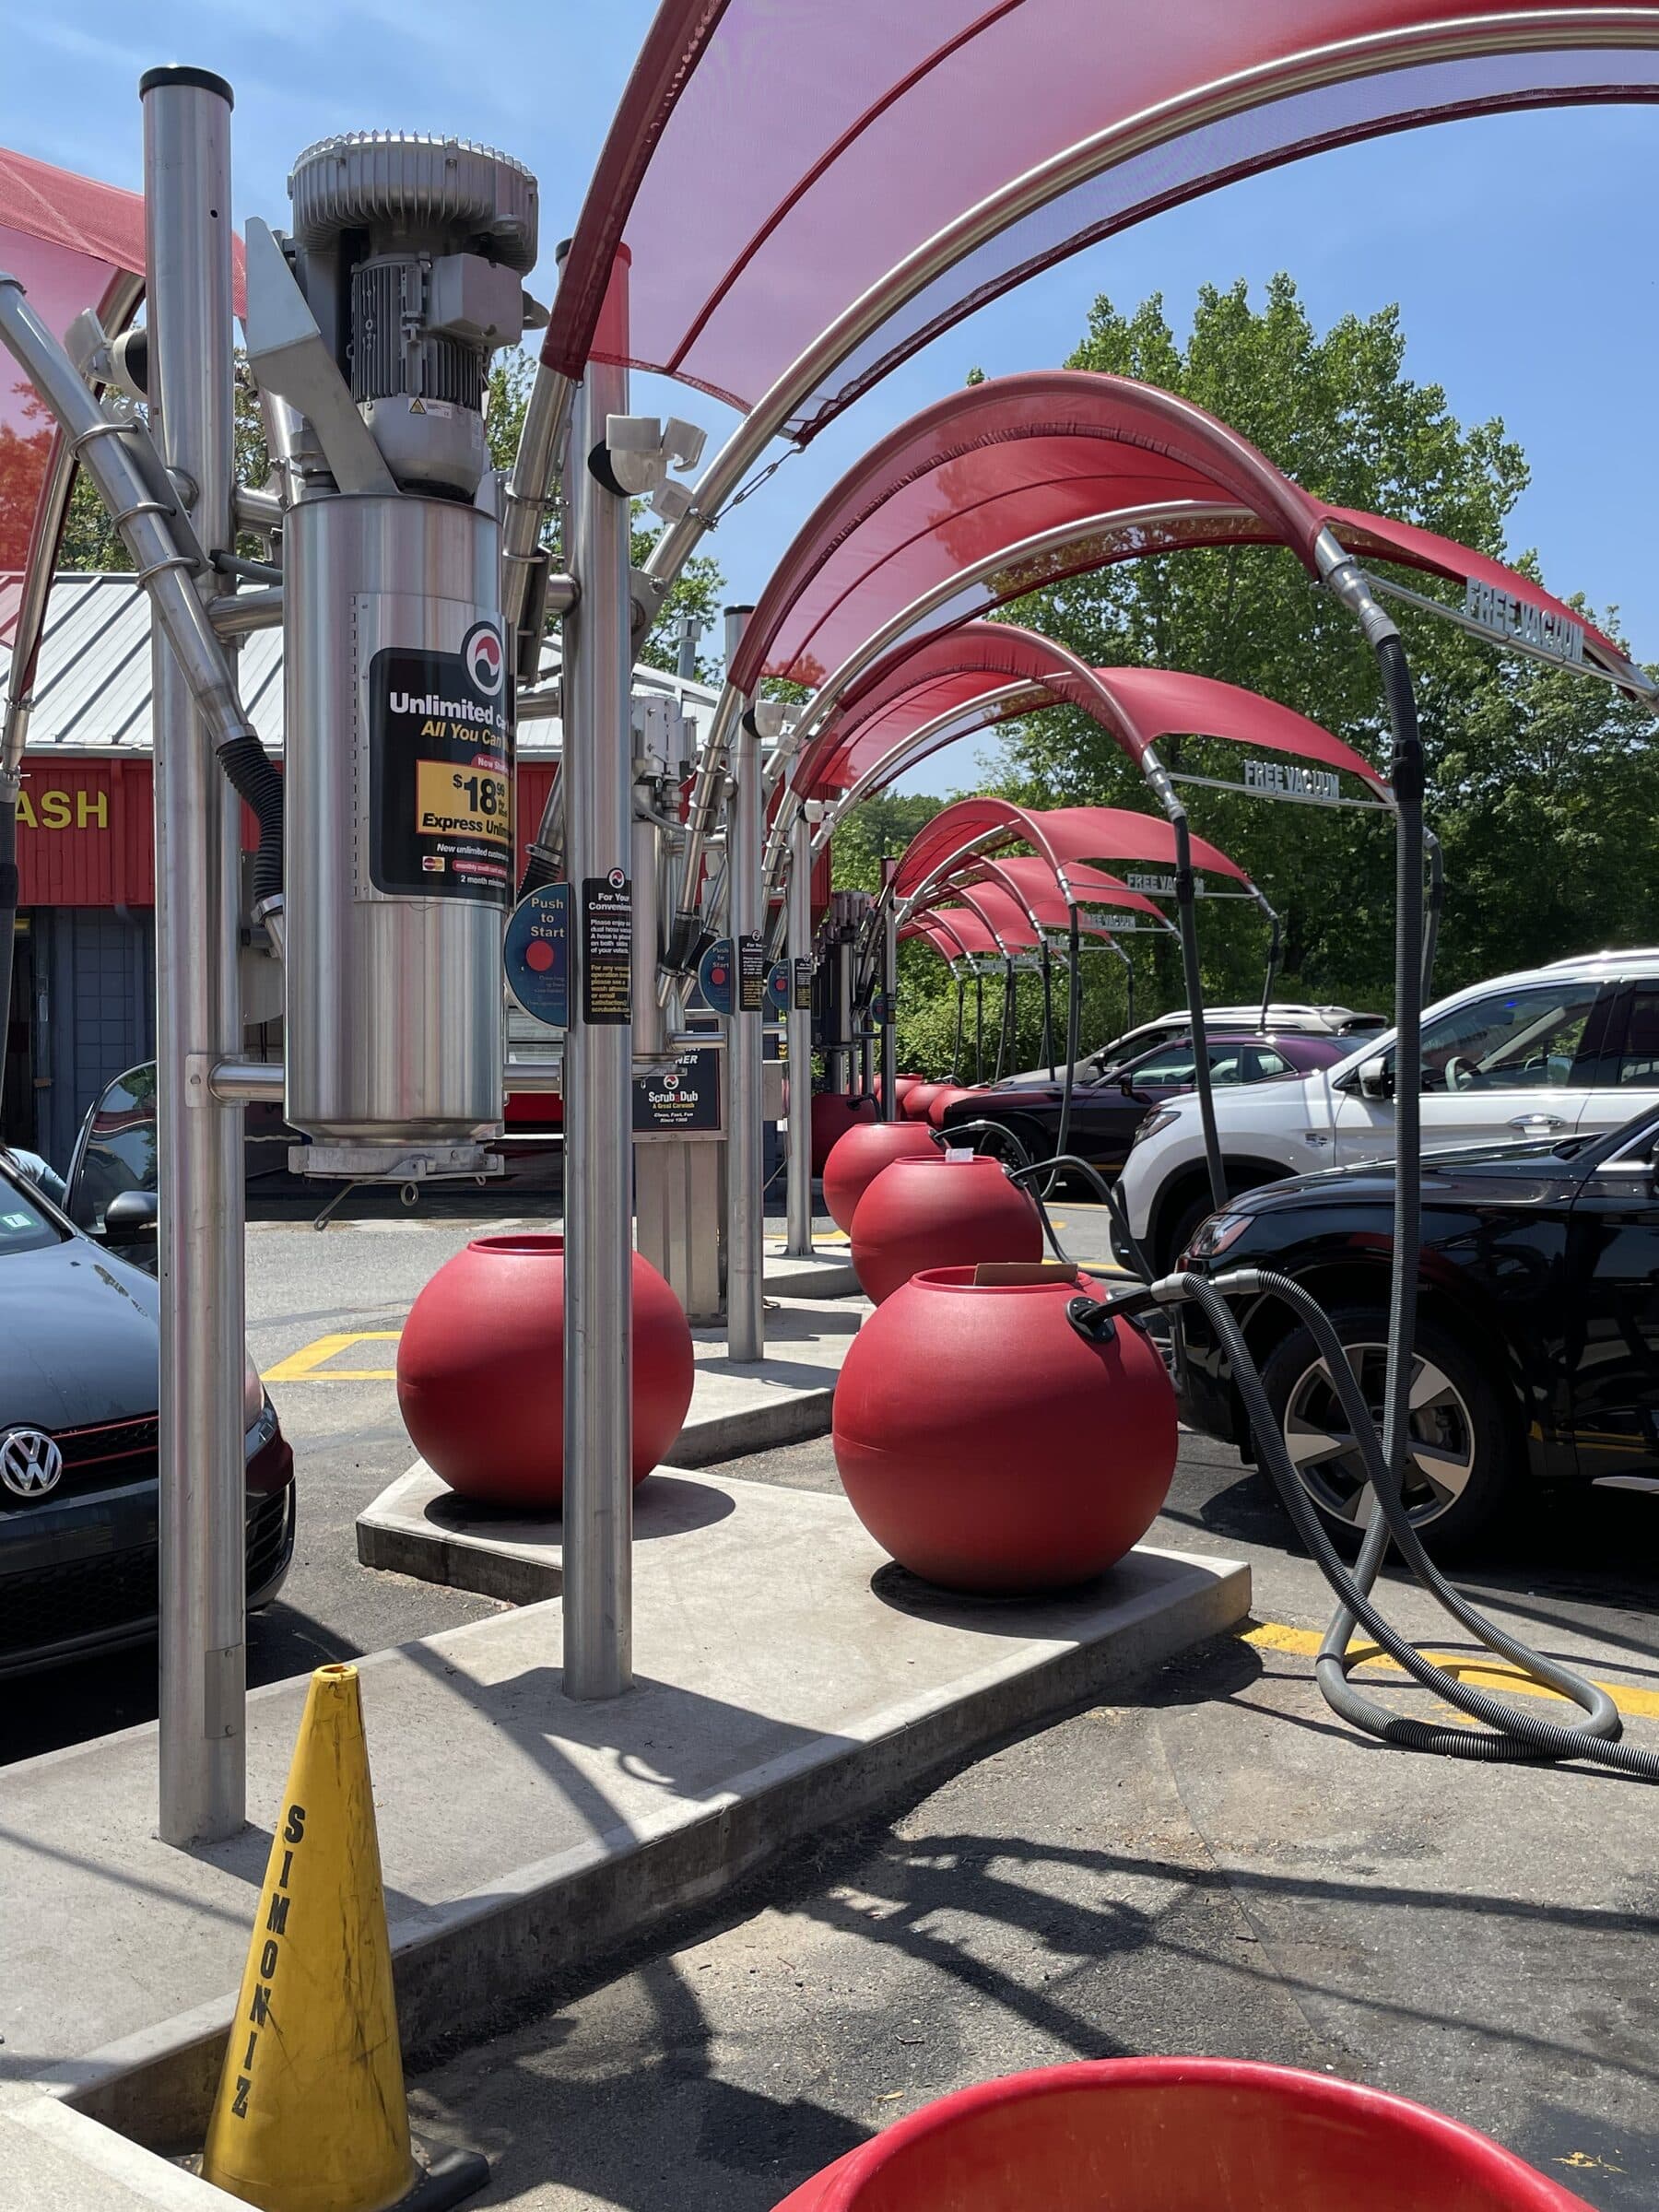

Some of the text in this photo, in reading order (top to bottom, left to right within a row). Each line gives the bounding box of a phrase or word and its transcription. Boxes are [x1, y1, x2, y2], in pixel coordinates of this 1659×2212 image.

[1466, 575, 1583, 663] FREE VACUUM
[390, 692, 494, 725] Unlimited
[420, 721, 447, 737] All
[451, 723, 479, 742] You
[482, 729, 502, 749] Can
[1243, 760, 1340, 799] FREE VACUUM
[15, 791, 108, 829] ASH
[422, 812, 483, 832] Express
[437, 843, 455, 853] New
[456, 845, 488, 857] unlimited
[1127, 874, 1159, 889] FREE
[531, 898, 564, 910] Push
[598, 893, 613, 901] For
[541, 913, 555, 924] to
[531, 926, 565, 938] Start
[230, 1805, 305, 2119] SIMONIZ
